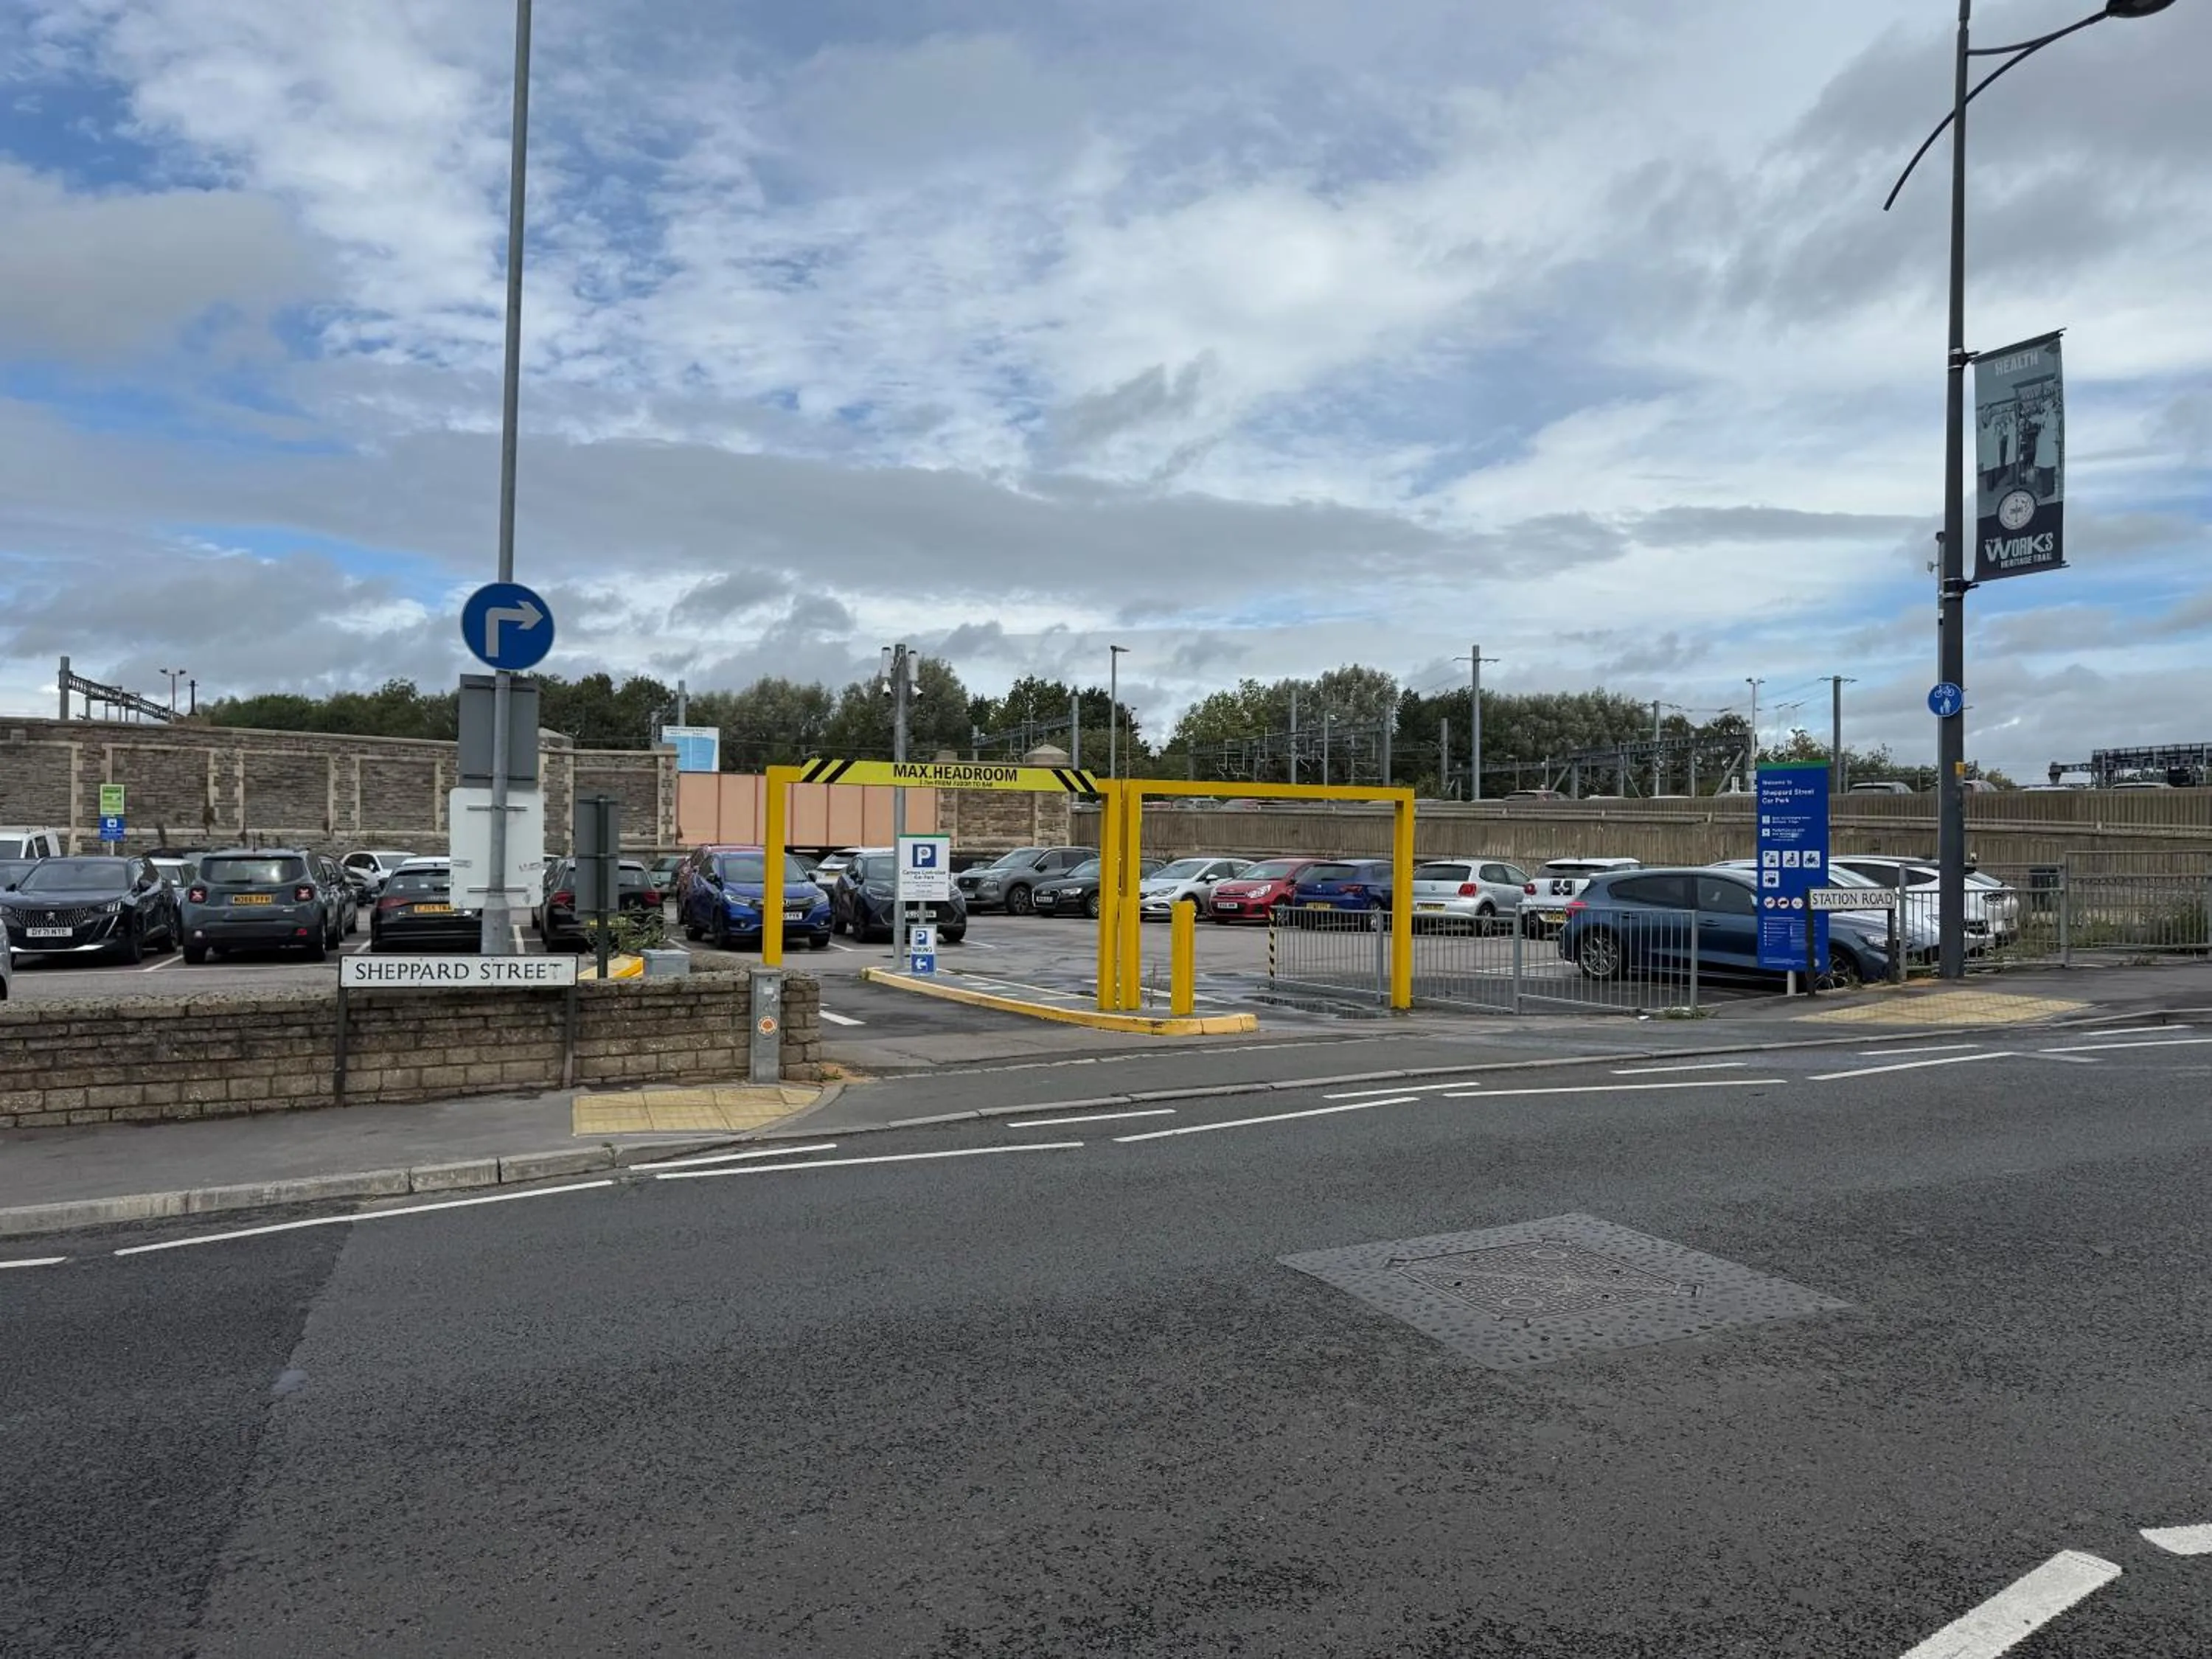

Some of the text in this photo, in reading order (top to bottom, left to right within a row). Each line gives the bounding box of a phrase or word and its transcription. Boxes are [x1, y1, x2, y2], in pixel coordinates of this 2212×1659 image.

[1994, 350, 2038, 377] HEALTH
[894, 764, 1018, 782] MAX.HEADROOM
[1812, 893, 1893, 905] STATION ROAD
[355, 963, 562, 980] SHEPPARD STREET
